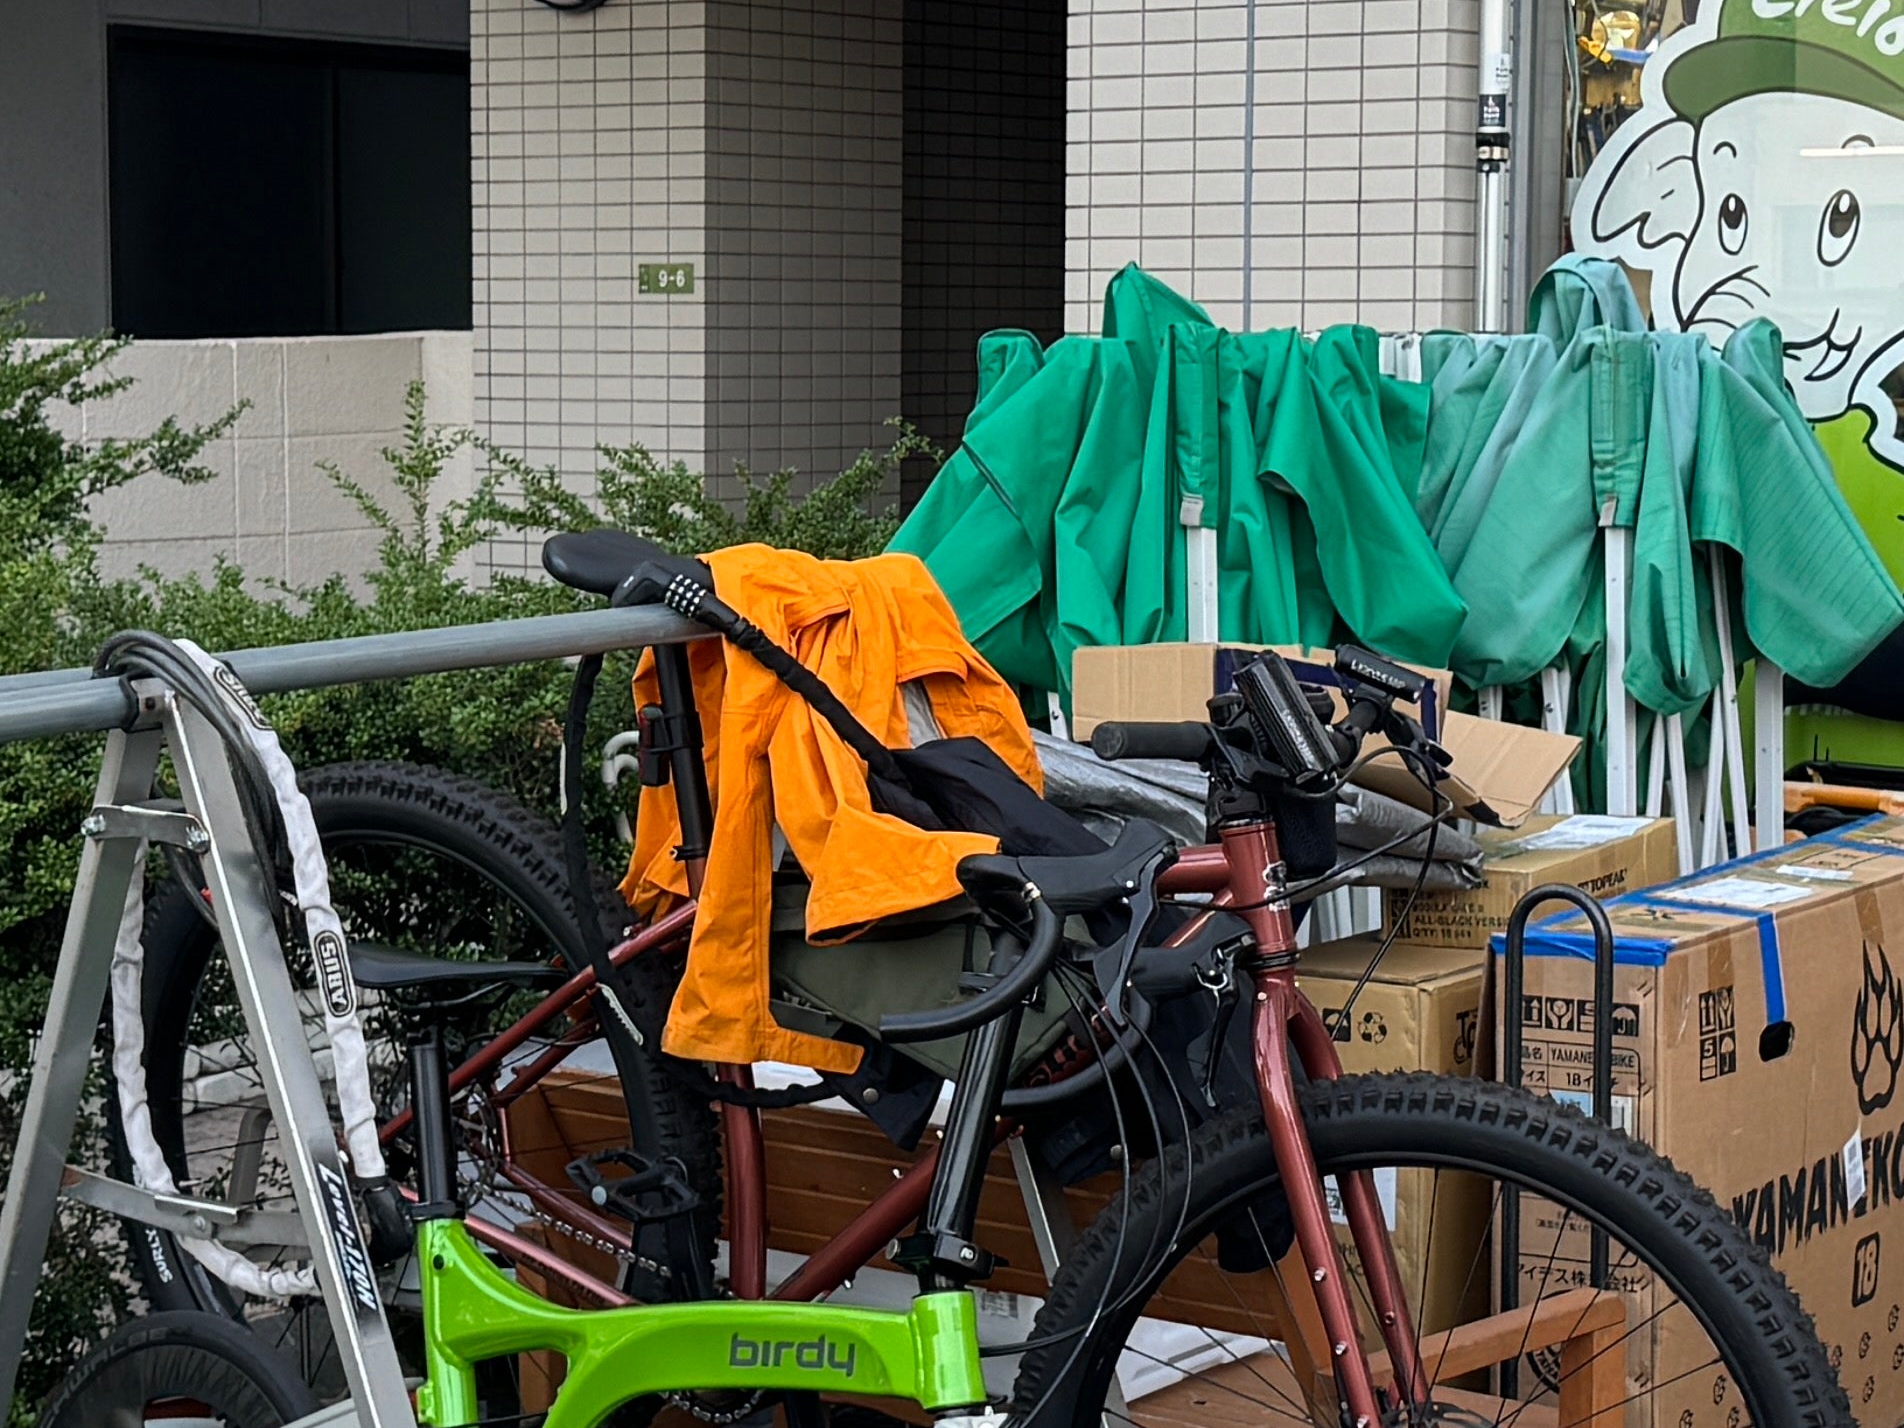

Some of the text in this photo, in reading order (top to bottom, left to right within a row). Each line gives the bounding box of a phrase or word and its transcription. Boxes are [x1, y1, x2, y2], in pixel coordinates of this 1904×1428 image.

[658, 269, 686, 288] 9-6
[318, 940, 348, 1012] ABUS
[1550, 1047, 1594, 1064] YAMANE
[145, 1228, 174, 1284] SURLY
[1518, 1263, 1638, 1293] イデス株会社
[1855, 1238, 1879, 1303] 18
[728, 1332, 856, 1378] birdy
